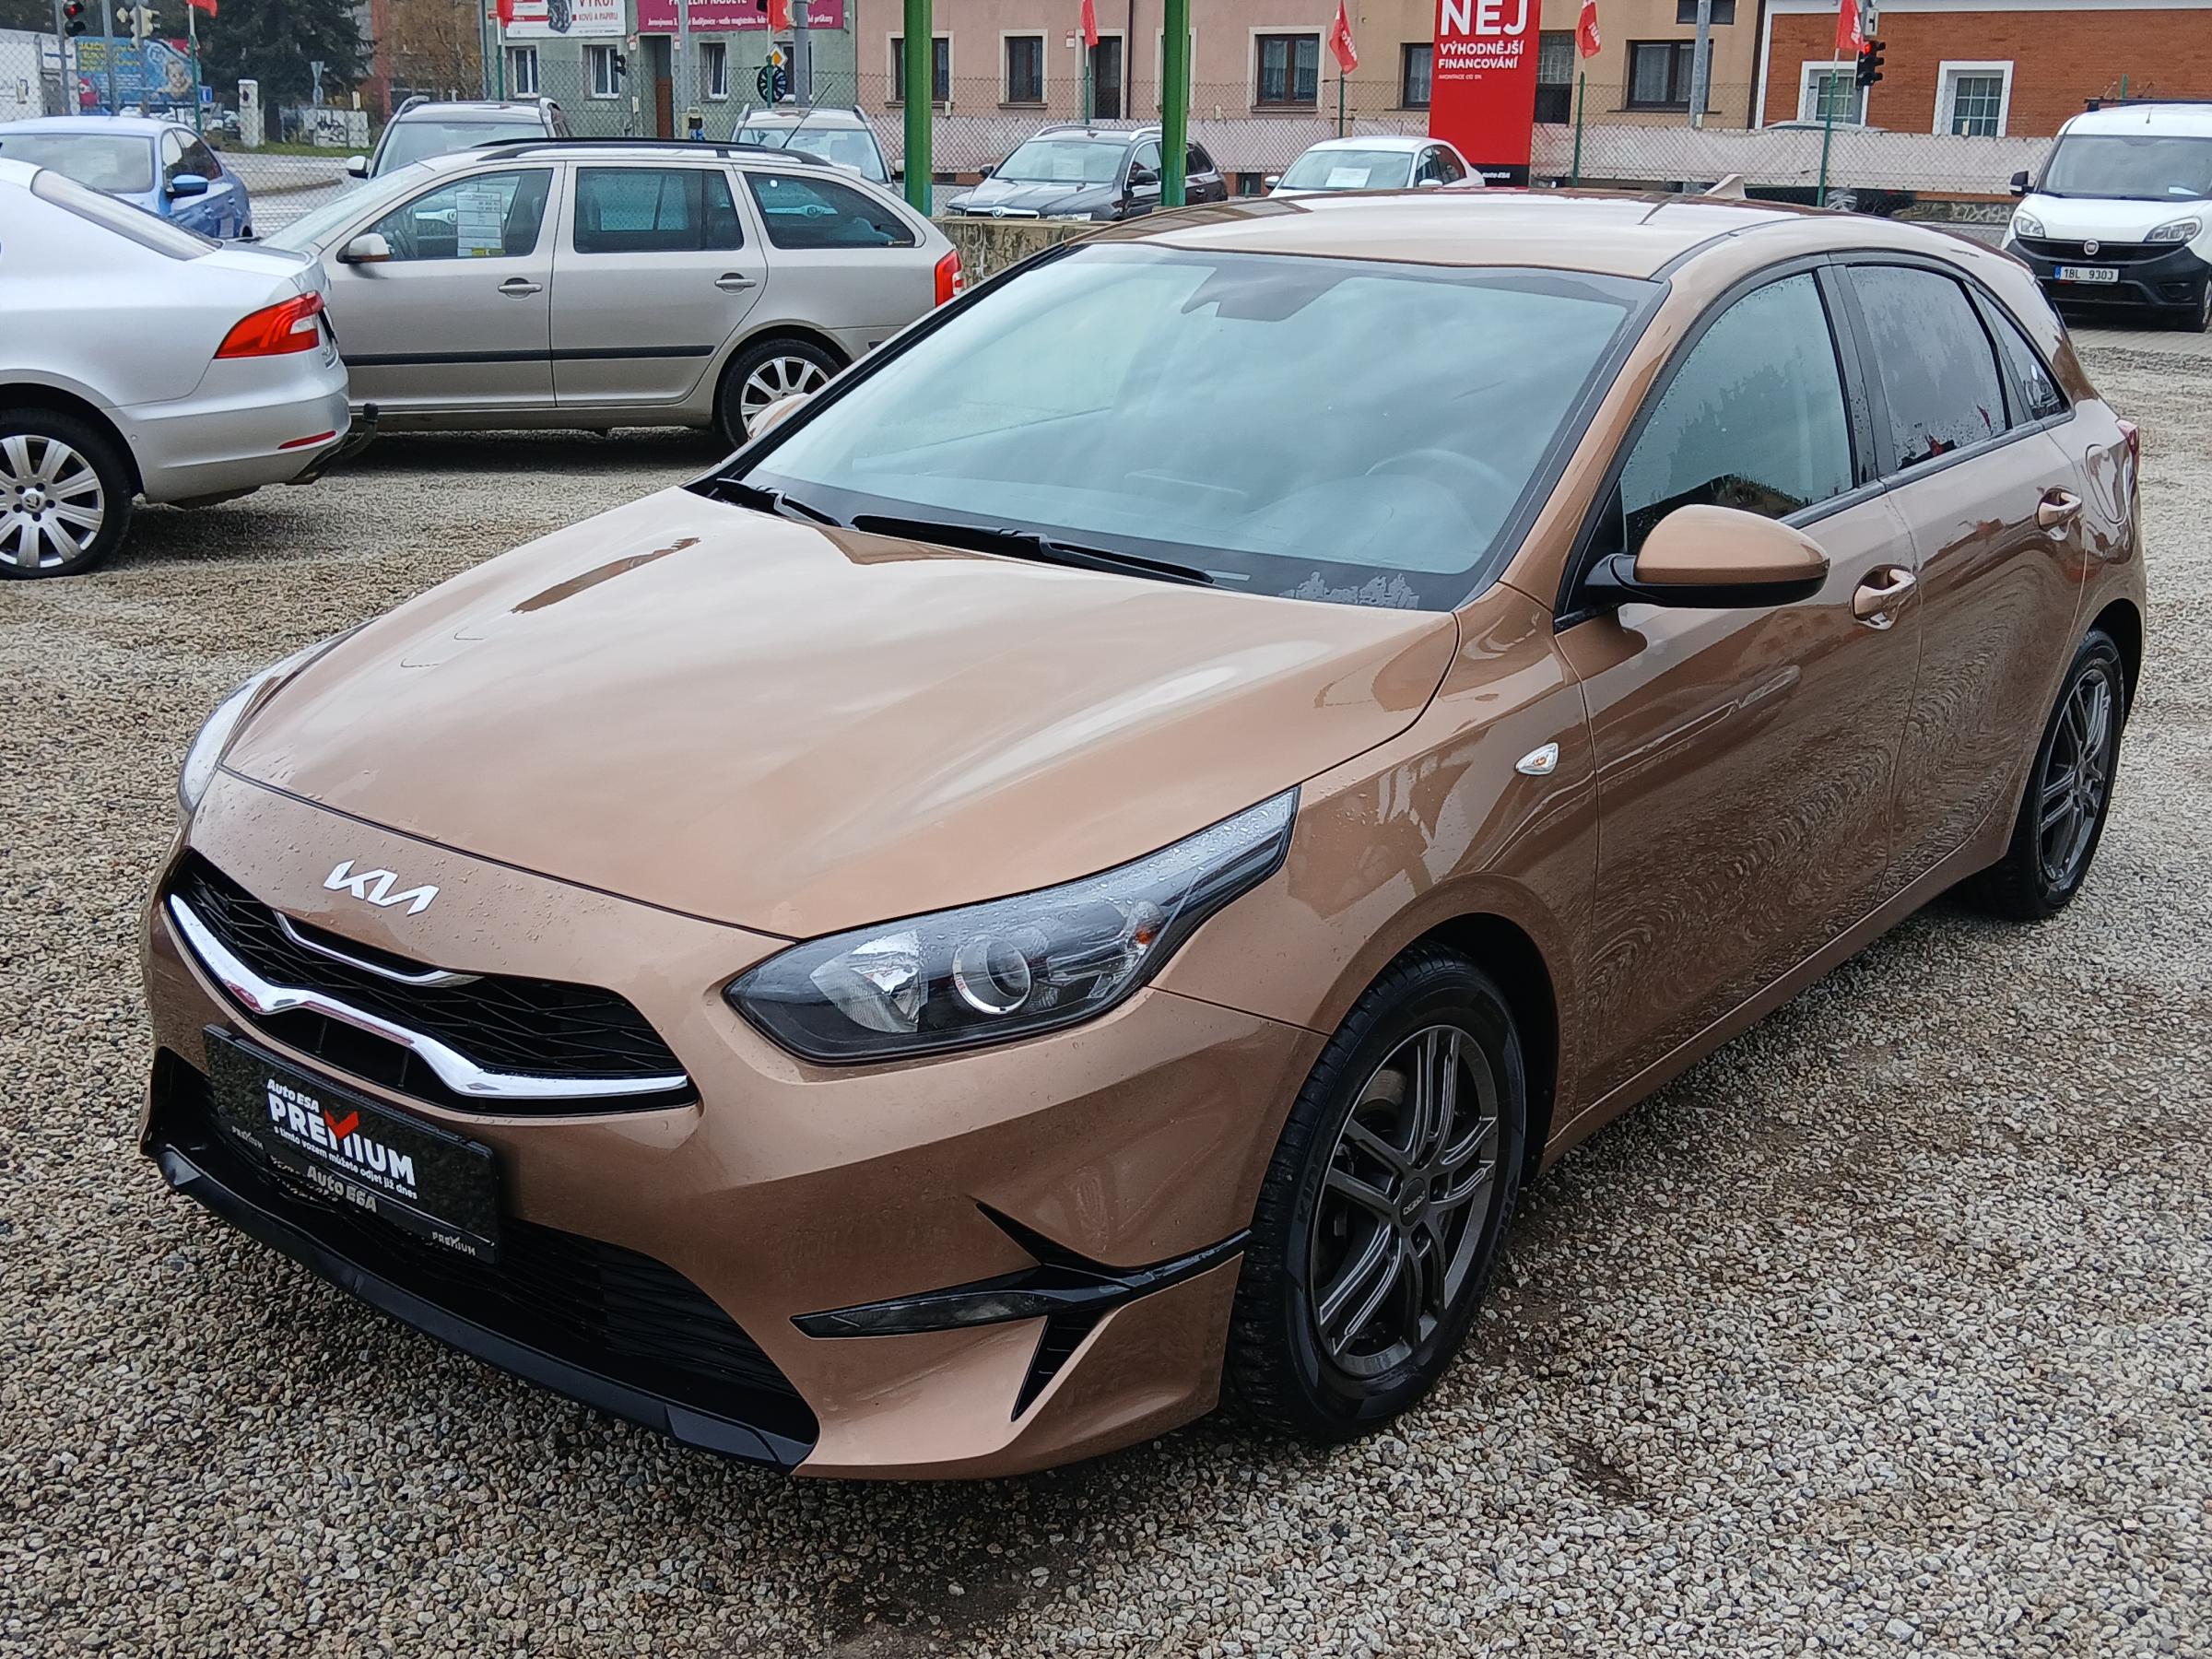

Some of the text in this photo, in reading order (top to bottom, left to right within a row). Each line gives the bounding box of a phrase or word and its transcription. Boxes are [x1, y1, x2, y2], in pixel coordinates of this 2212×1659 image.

[1440, 0, 1528, 35] NEJ
[1438, 56, 1519, 69] FINANCOVÁNÍ
[1440, 40, 1524, 55] VÝHODNĚJŠÍ
[2064, 268, 2114, 280] 1BL 9303
[266, 1078, 320, 1113] Auto ESA
[268, 1091, 416, 1187] PREMIUM
[307, 1165, 345, 1196] Auto
